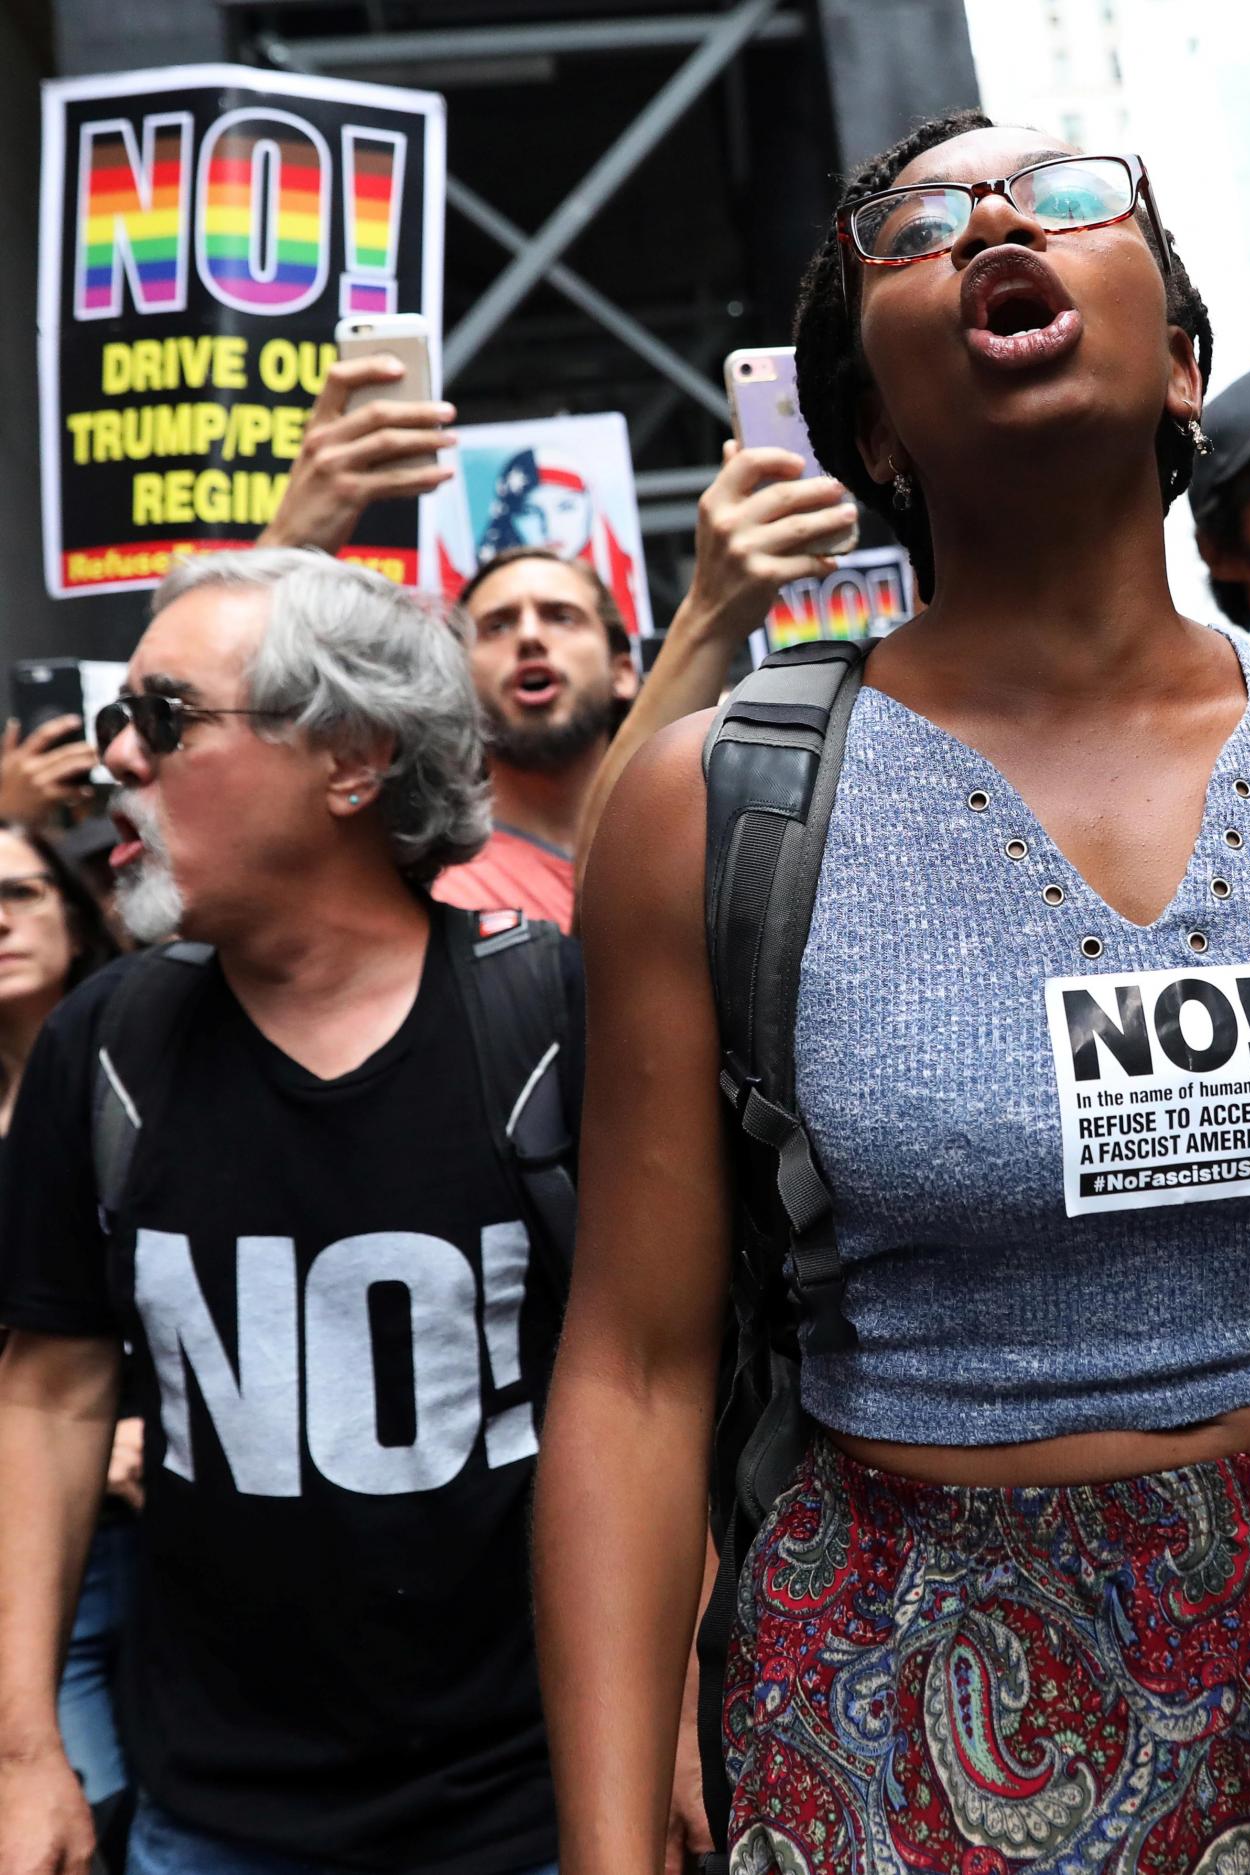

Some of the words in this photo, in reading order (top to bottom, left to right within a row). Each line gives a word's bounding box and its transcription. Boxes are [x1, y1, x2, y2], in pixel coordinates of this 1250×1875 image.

[74, 106, 407, 321] NO!
[102, 336, 248, 395] DRIVE
[259, 338, 339, 394] OU
[67, 402, 307, 465] TRUMP/PE
[132, 468, 291, 526] REGIM
[1076, 1093, 1092, 1109] In
[1098, 1091, 1123, 1107] the
[1130, 1088, 1173, 1104] name
[1178, 1082, 1194, 1099] of
[1079, 1111, 1156, 1139] REFUSE
[1165, 1108, 1190, 1130] TO
[1080, 1144, 1094, 1165] A
[1099, 1135, 1181, 1163] FASCIST
[134, 1219, 540, 1498] NO!
